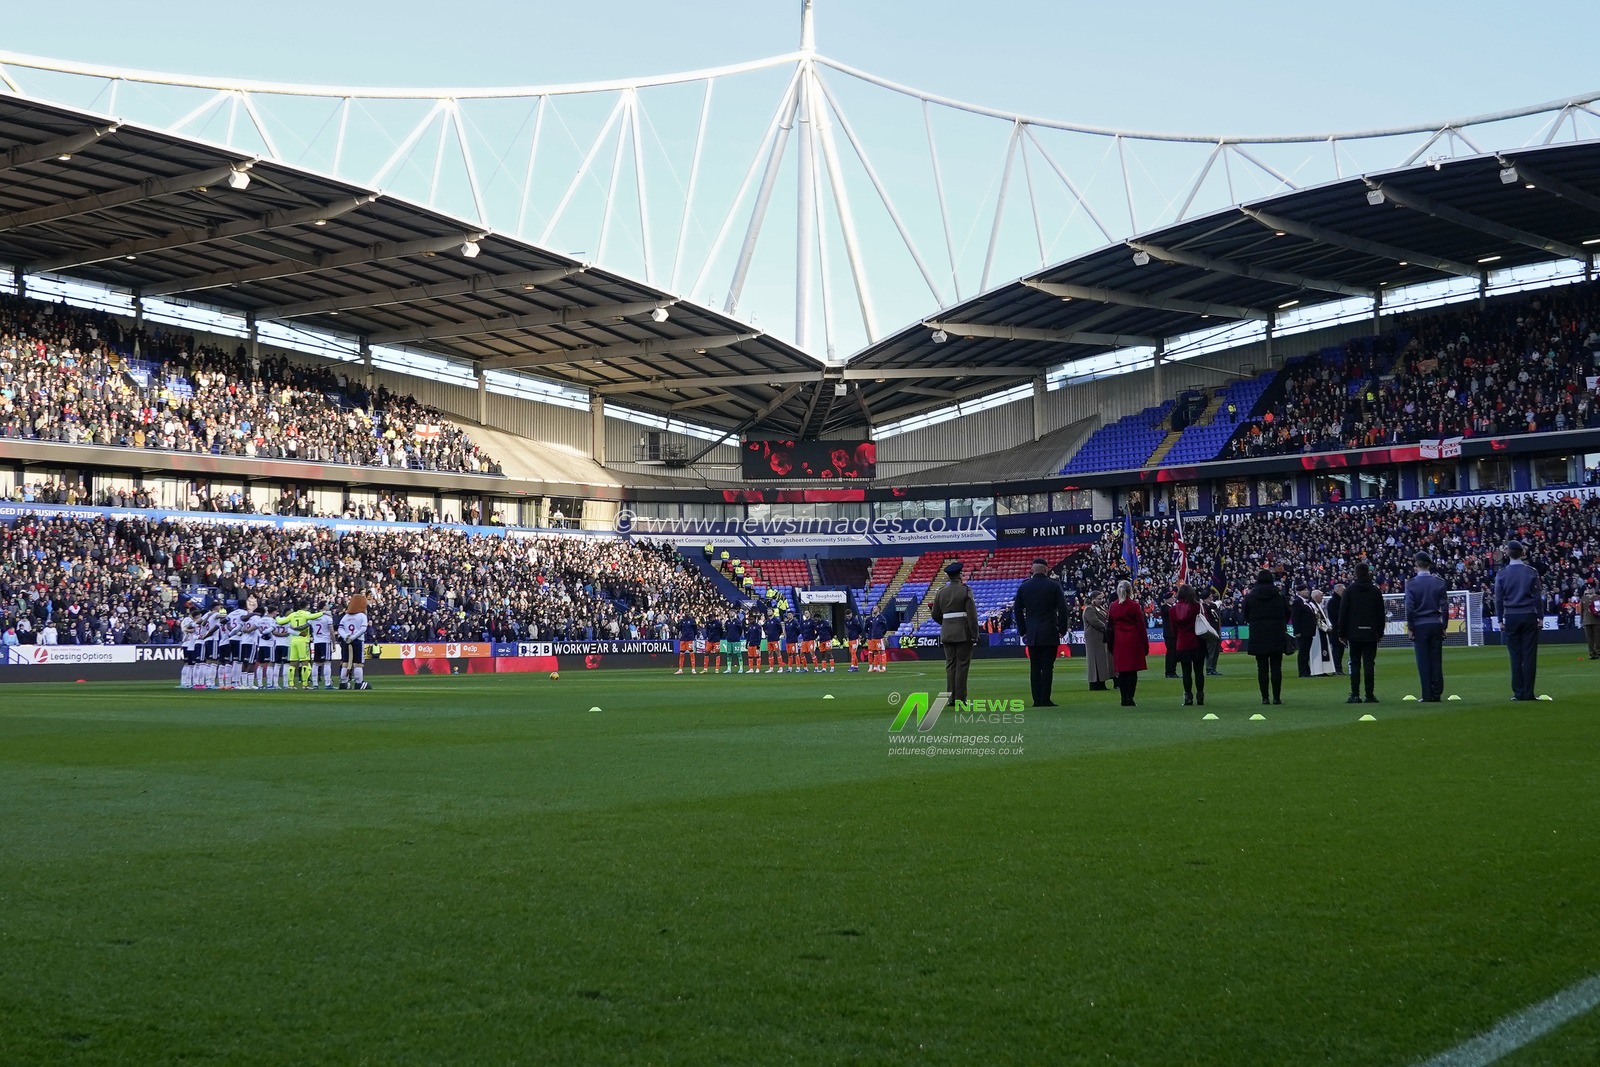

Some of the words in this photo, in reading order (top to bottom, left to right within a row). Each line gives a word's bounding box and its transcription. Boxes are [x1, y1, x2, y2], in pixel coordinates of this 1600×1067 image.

[1411, 496, 1487, 511] FRANKING
[1033, 525, 1066, 537] PRINT
[773, 537, 804, 545] Toughsheet
[898, 534, 928, 542] Toughsheet
[930, 533, 960, 541] Community
[315, 623, 322, 635] 2
[348, 623, 355, 635] 9
[554, 642, 609, 654] WORKWEAR
[612, 643, 619, 653] &
[621, 642, 673, 653] JANITORIAL
